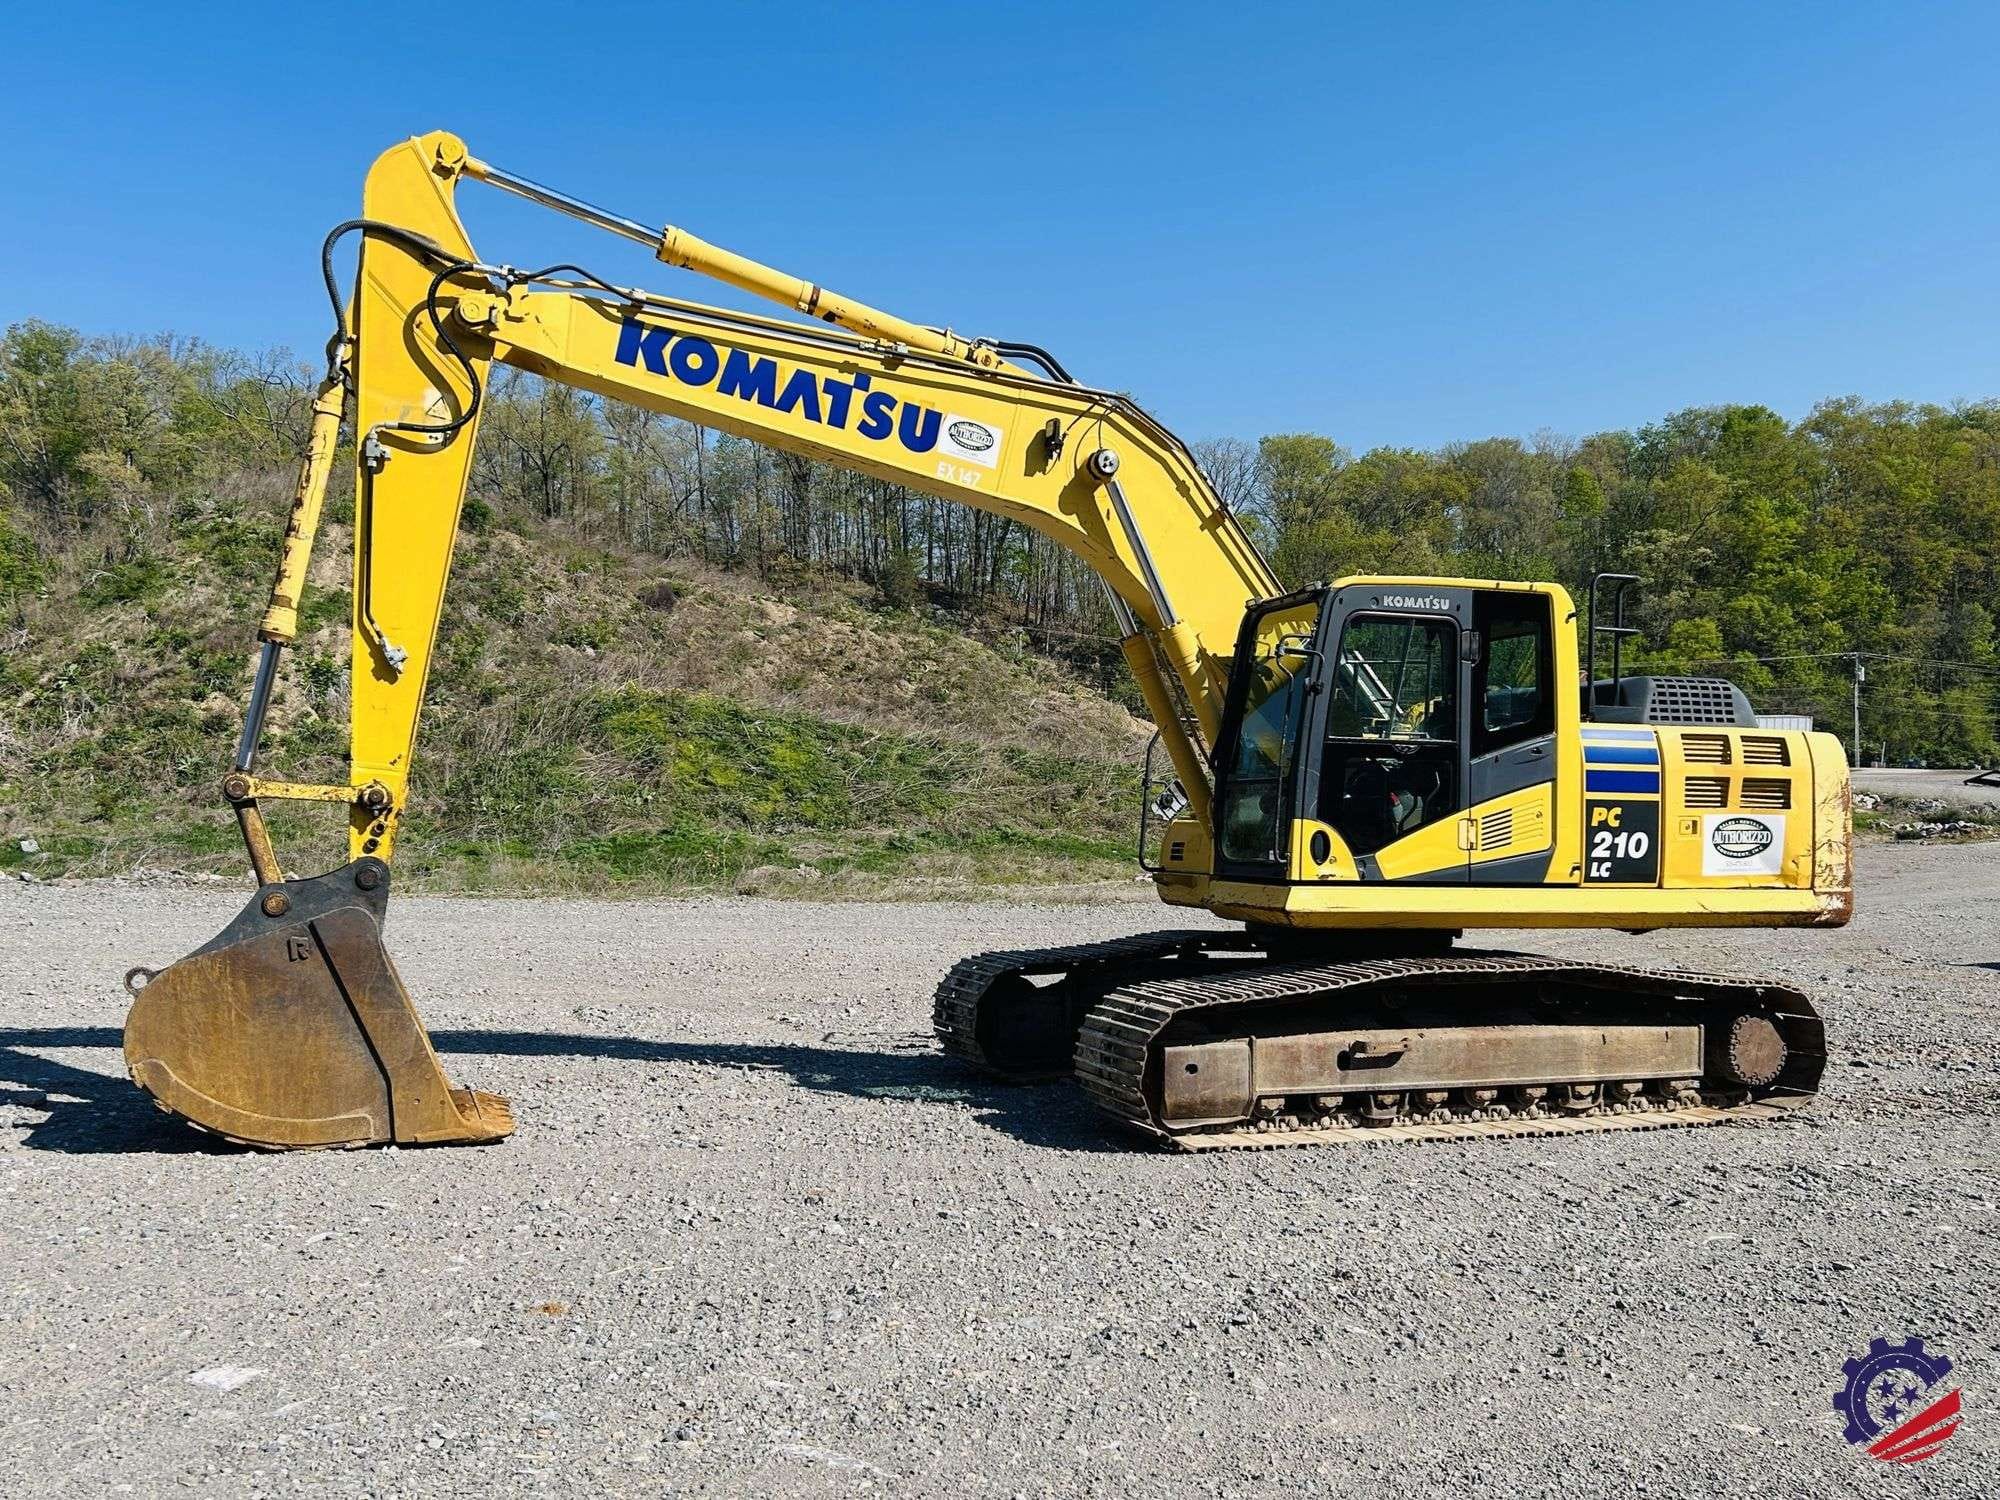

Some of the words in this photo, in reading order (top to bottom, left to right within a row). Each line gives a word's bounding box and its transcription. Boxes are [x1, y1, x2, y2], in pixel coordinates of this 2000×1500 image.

[615, 315, 943, 452] KOMATSU
[936, 462, 957, 480] EX
[959, 466, 982, 487] 147
[1383, 595, 1450, 610] KOMATSU
[1591, 807, 1622, 827] PC
[1590, 831, 1649, 859] 210
[1713, 830, 1771, 843] AUTHORIZED
[1589, 862, 1612, 877] LC
